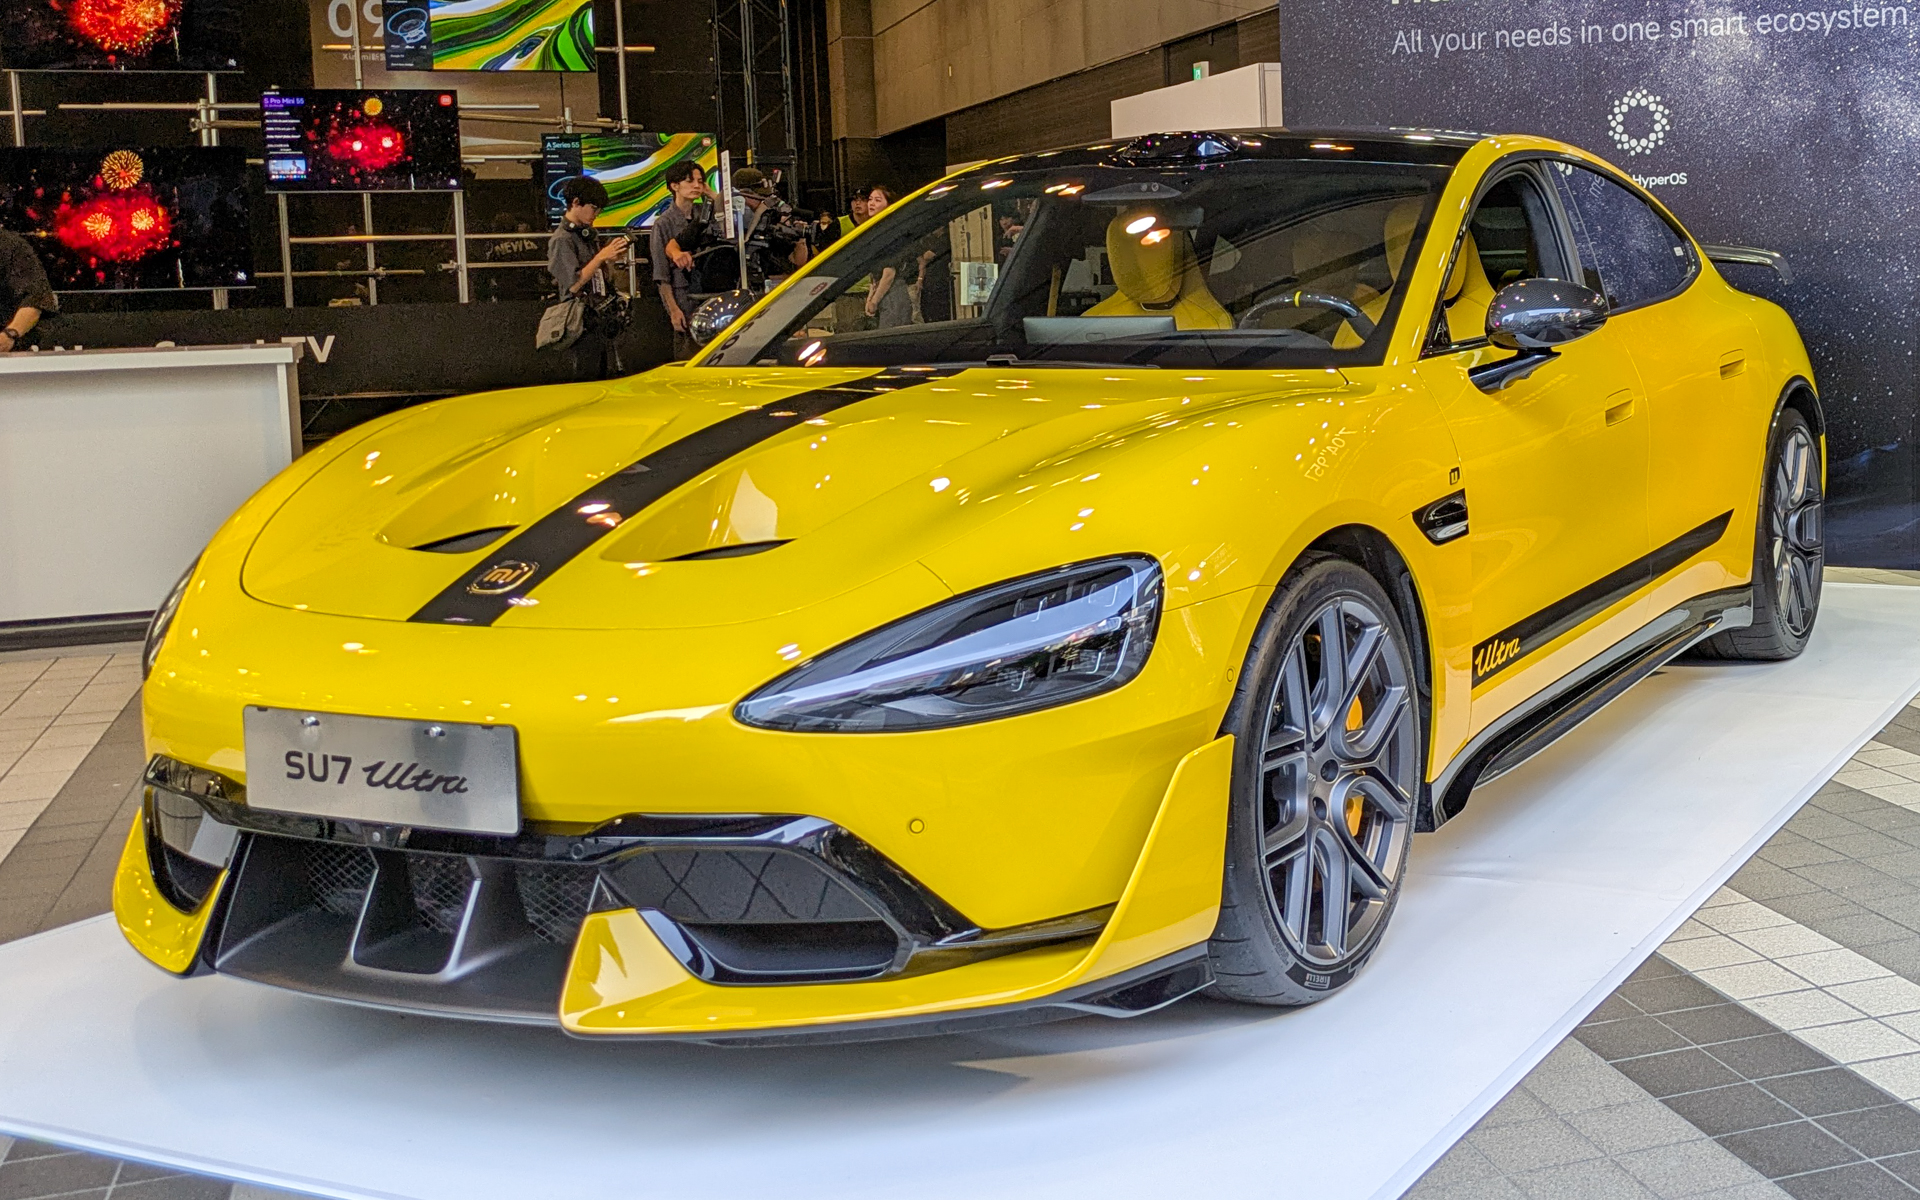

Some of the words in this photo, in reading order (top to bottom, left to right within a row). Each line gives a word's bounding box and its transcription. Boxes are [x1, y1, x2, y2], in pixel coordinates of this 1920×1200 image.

[1391, 29, 1423, 55] All
[1431, 31, 1487, 58] your
[1495, 21, 1572, 48] needs
[1581, 19, 1603, 43] in
[1612, 21, 1661, 42] one
[1670, 11, 1748, 39] smart
[1756, 4, 1908, 36] ecosystem
[552, 141, 571, 149] Series
[1632, 172, 1688, 188] HyperOS
[1474, 637, 1521, 677] Ultra
[285, 750, 352, 784] SU7
[362, 760, 469, 794] Ultra
[1304, 973, 1331, 989] PIRELLI
